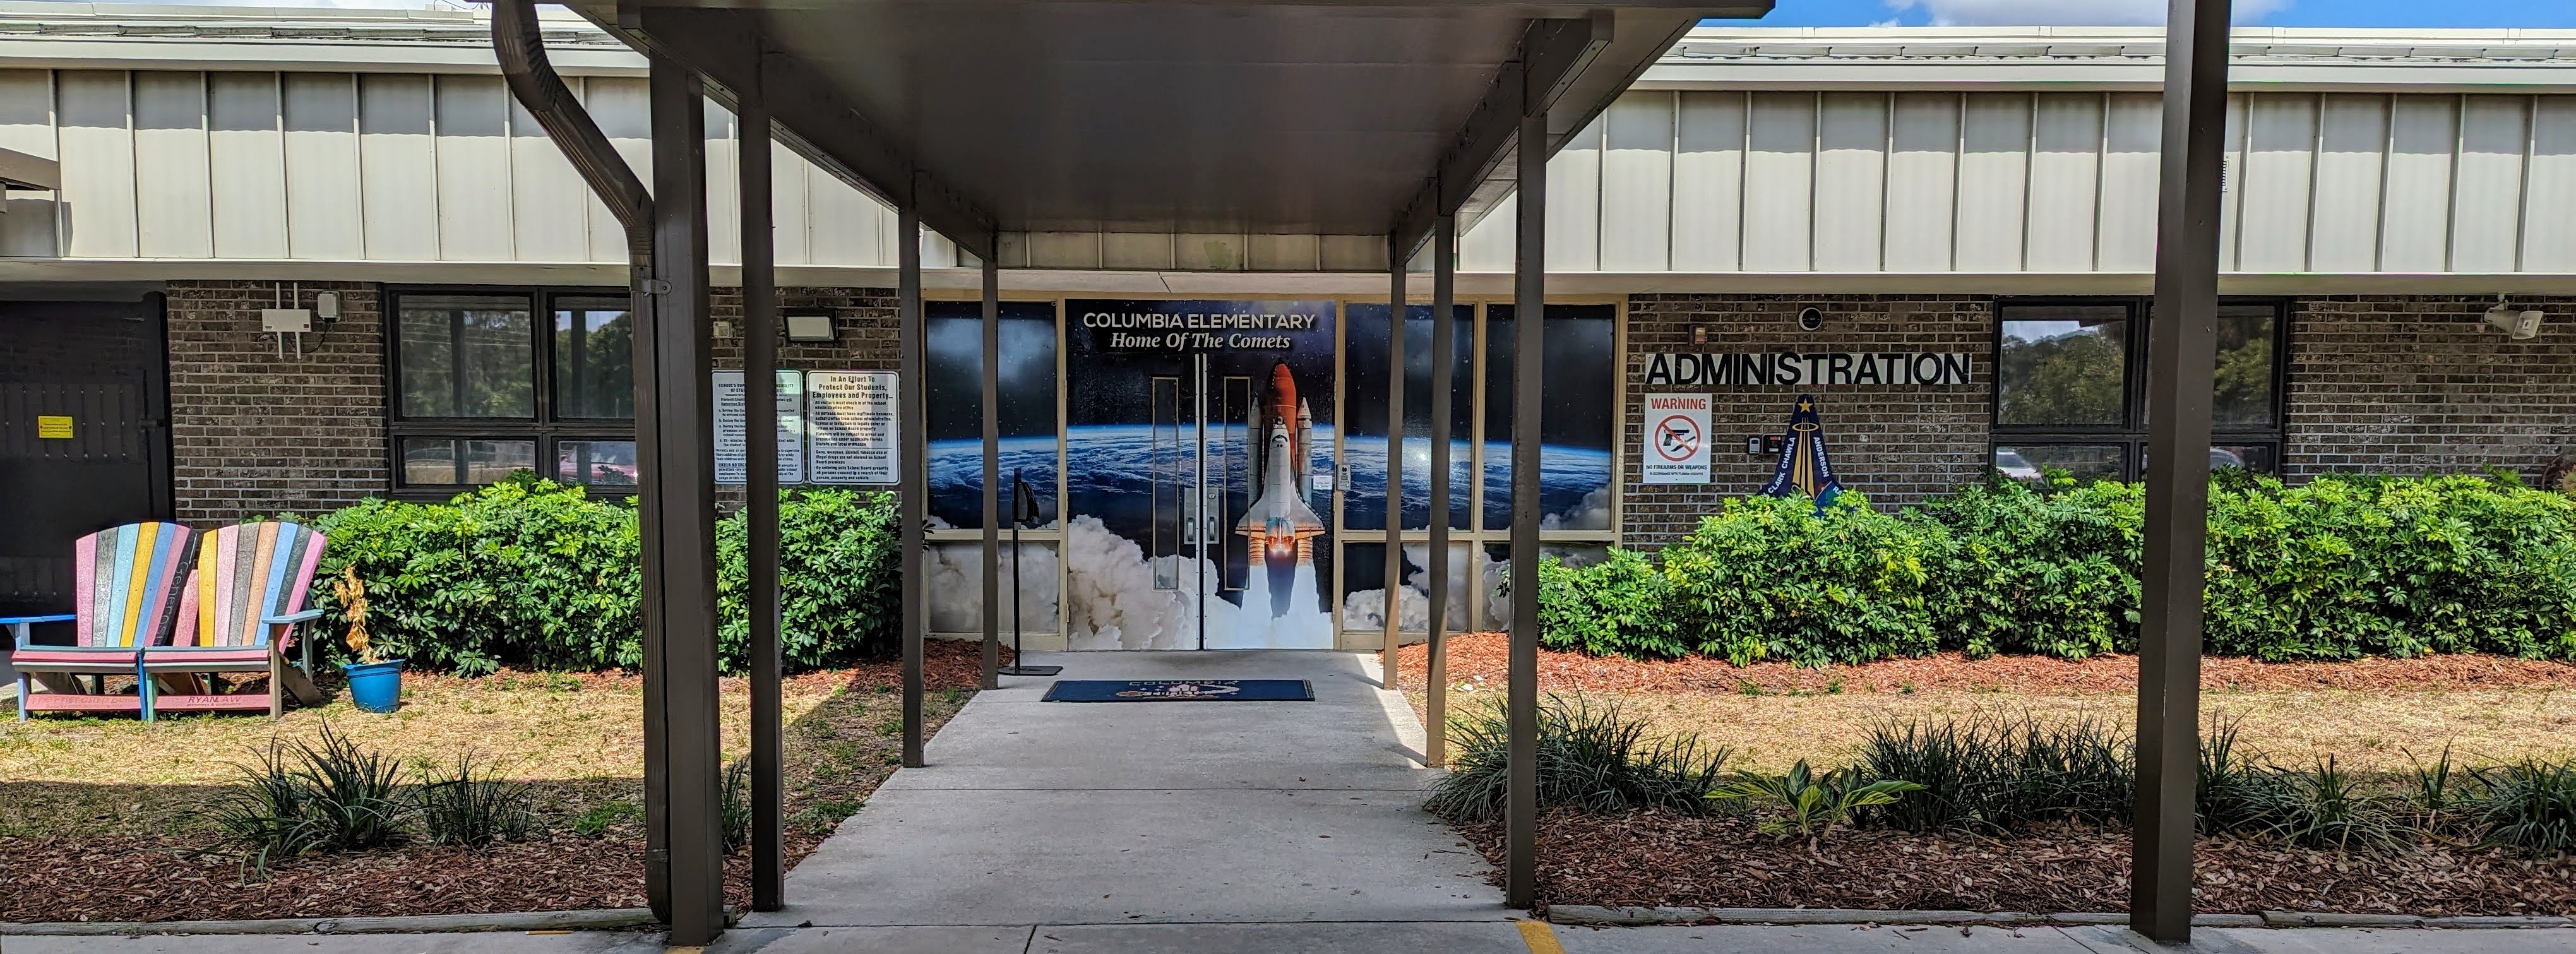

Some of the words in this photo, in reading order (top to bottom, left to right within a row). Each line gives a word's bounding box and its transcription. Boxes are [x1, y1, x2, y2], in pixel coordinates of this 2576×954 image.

[1083, 313, 1184, 328] COLUMBIA
[1188, 314, 1316, 329] ELEMENTARY
[1110, 332, 1160, 348] Home
[1166, 332, 1189, 352] Of
[1191, 333, 1223, 348] The
[1229, 333, 1291, 349] Comets
[1645, 352, 1971, 385] ADMINISTRATION
[1650, 398, 1707, 410] WARNING
[1768, 472, 1786, 494] CLARK
[1781, 437, 1796, 469] CHAWLA
[1813, 436, 1830, 478] ANDERSON
[1832, 486, 1843, 496] RA
